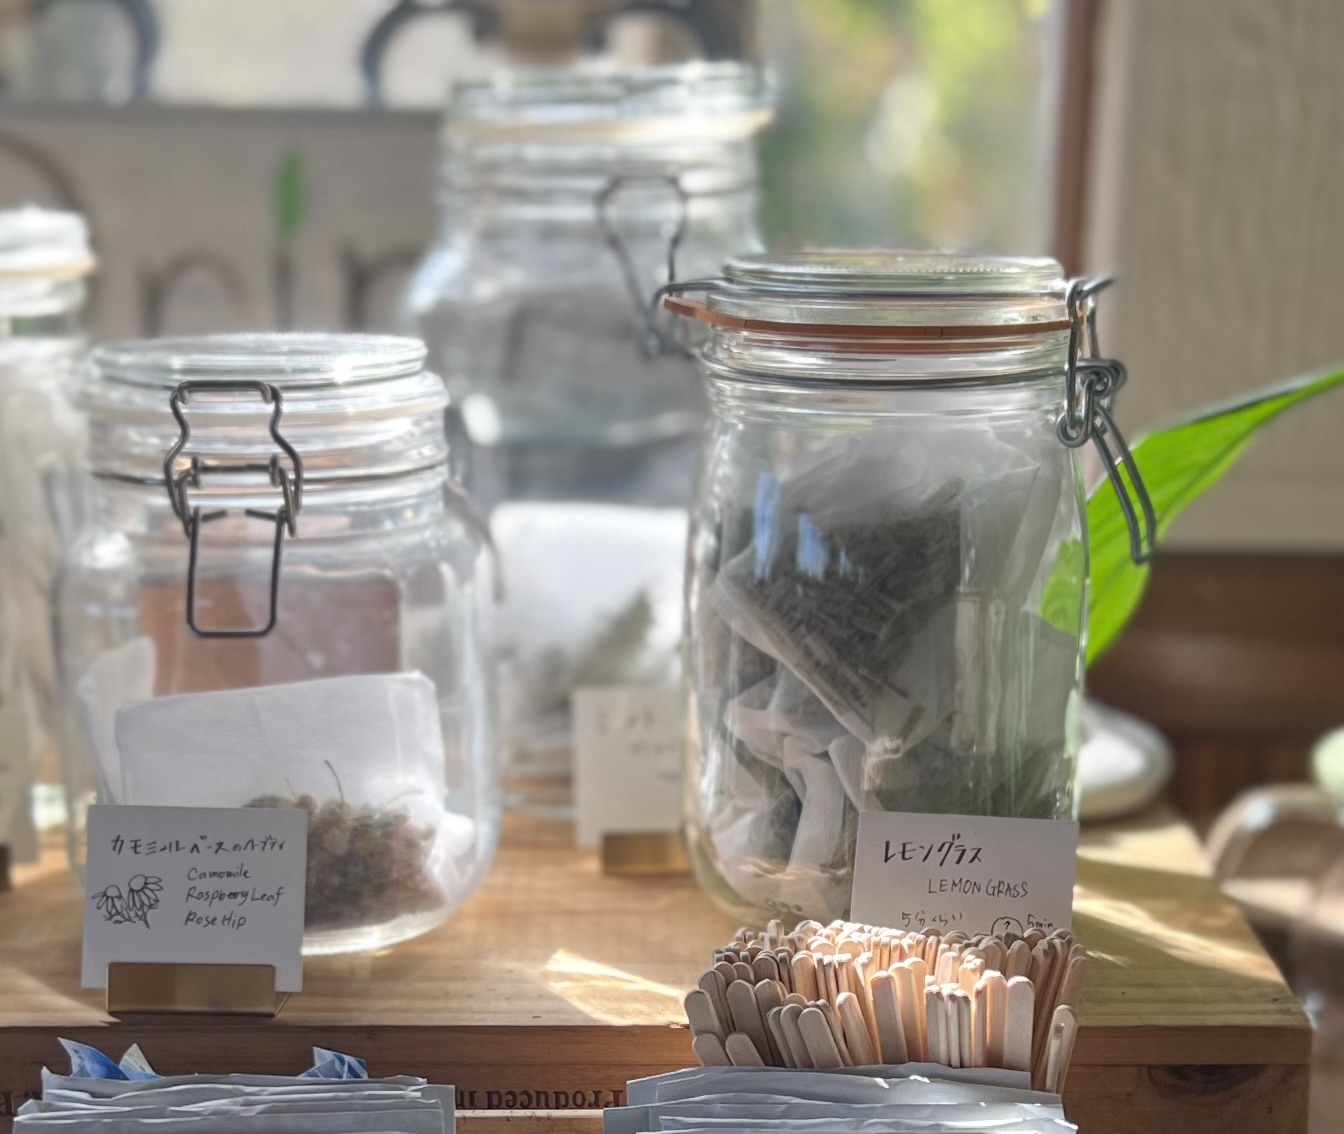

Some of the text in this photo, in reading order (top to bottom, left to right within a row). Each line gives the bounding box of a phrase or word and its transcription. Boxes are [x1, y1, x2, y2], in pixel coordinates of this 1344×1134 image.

[883, 833, 983, 867] レモングラス
[187, 863, 252, 881] Camomile
[250, 886, 286, 907] Leaf
[928, 878, 1029, 898] LEMON GRASS
[184, 910, 248, 930] Rose Hip
